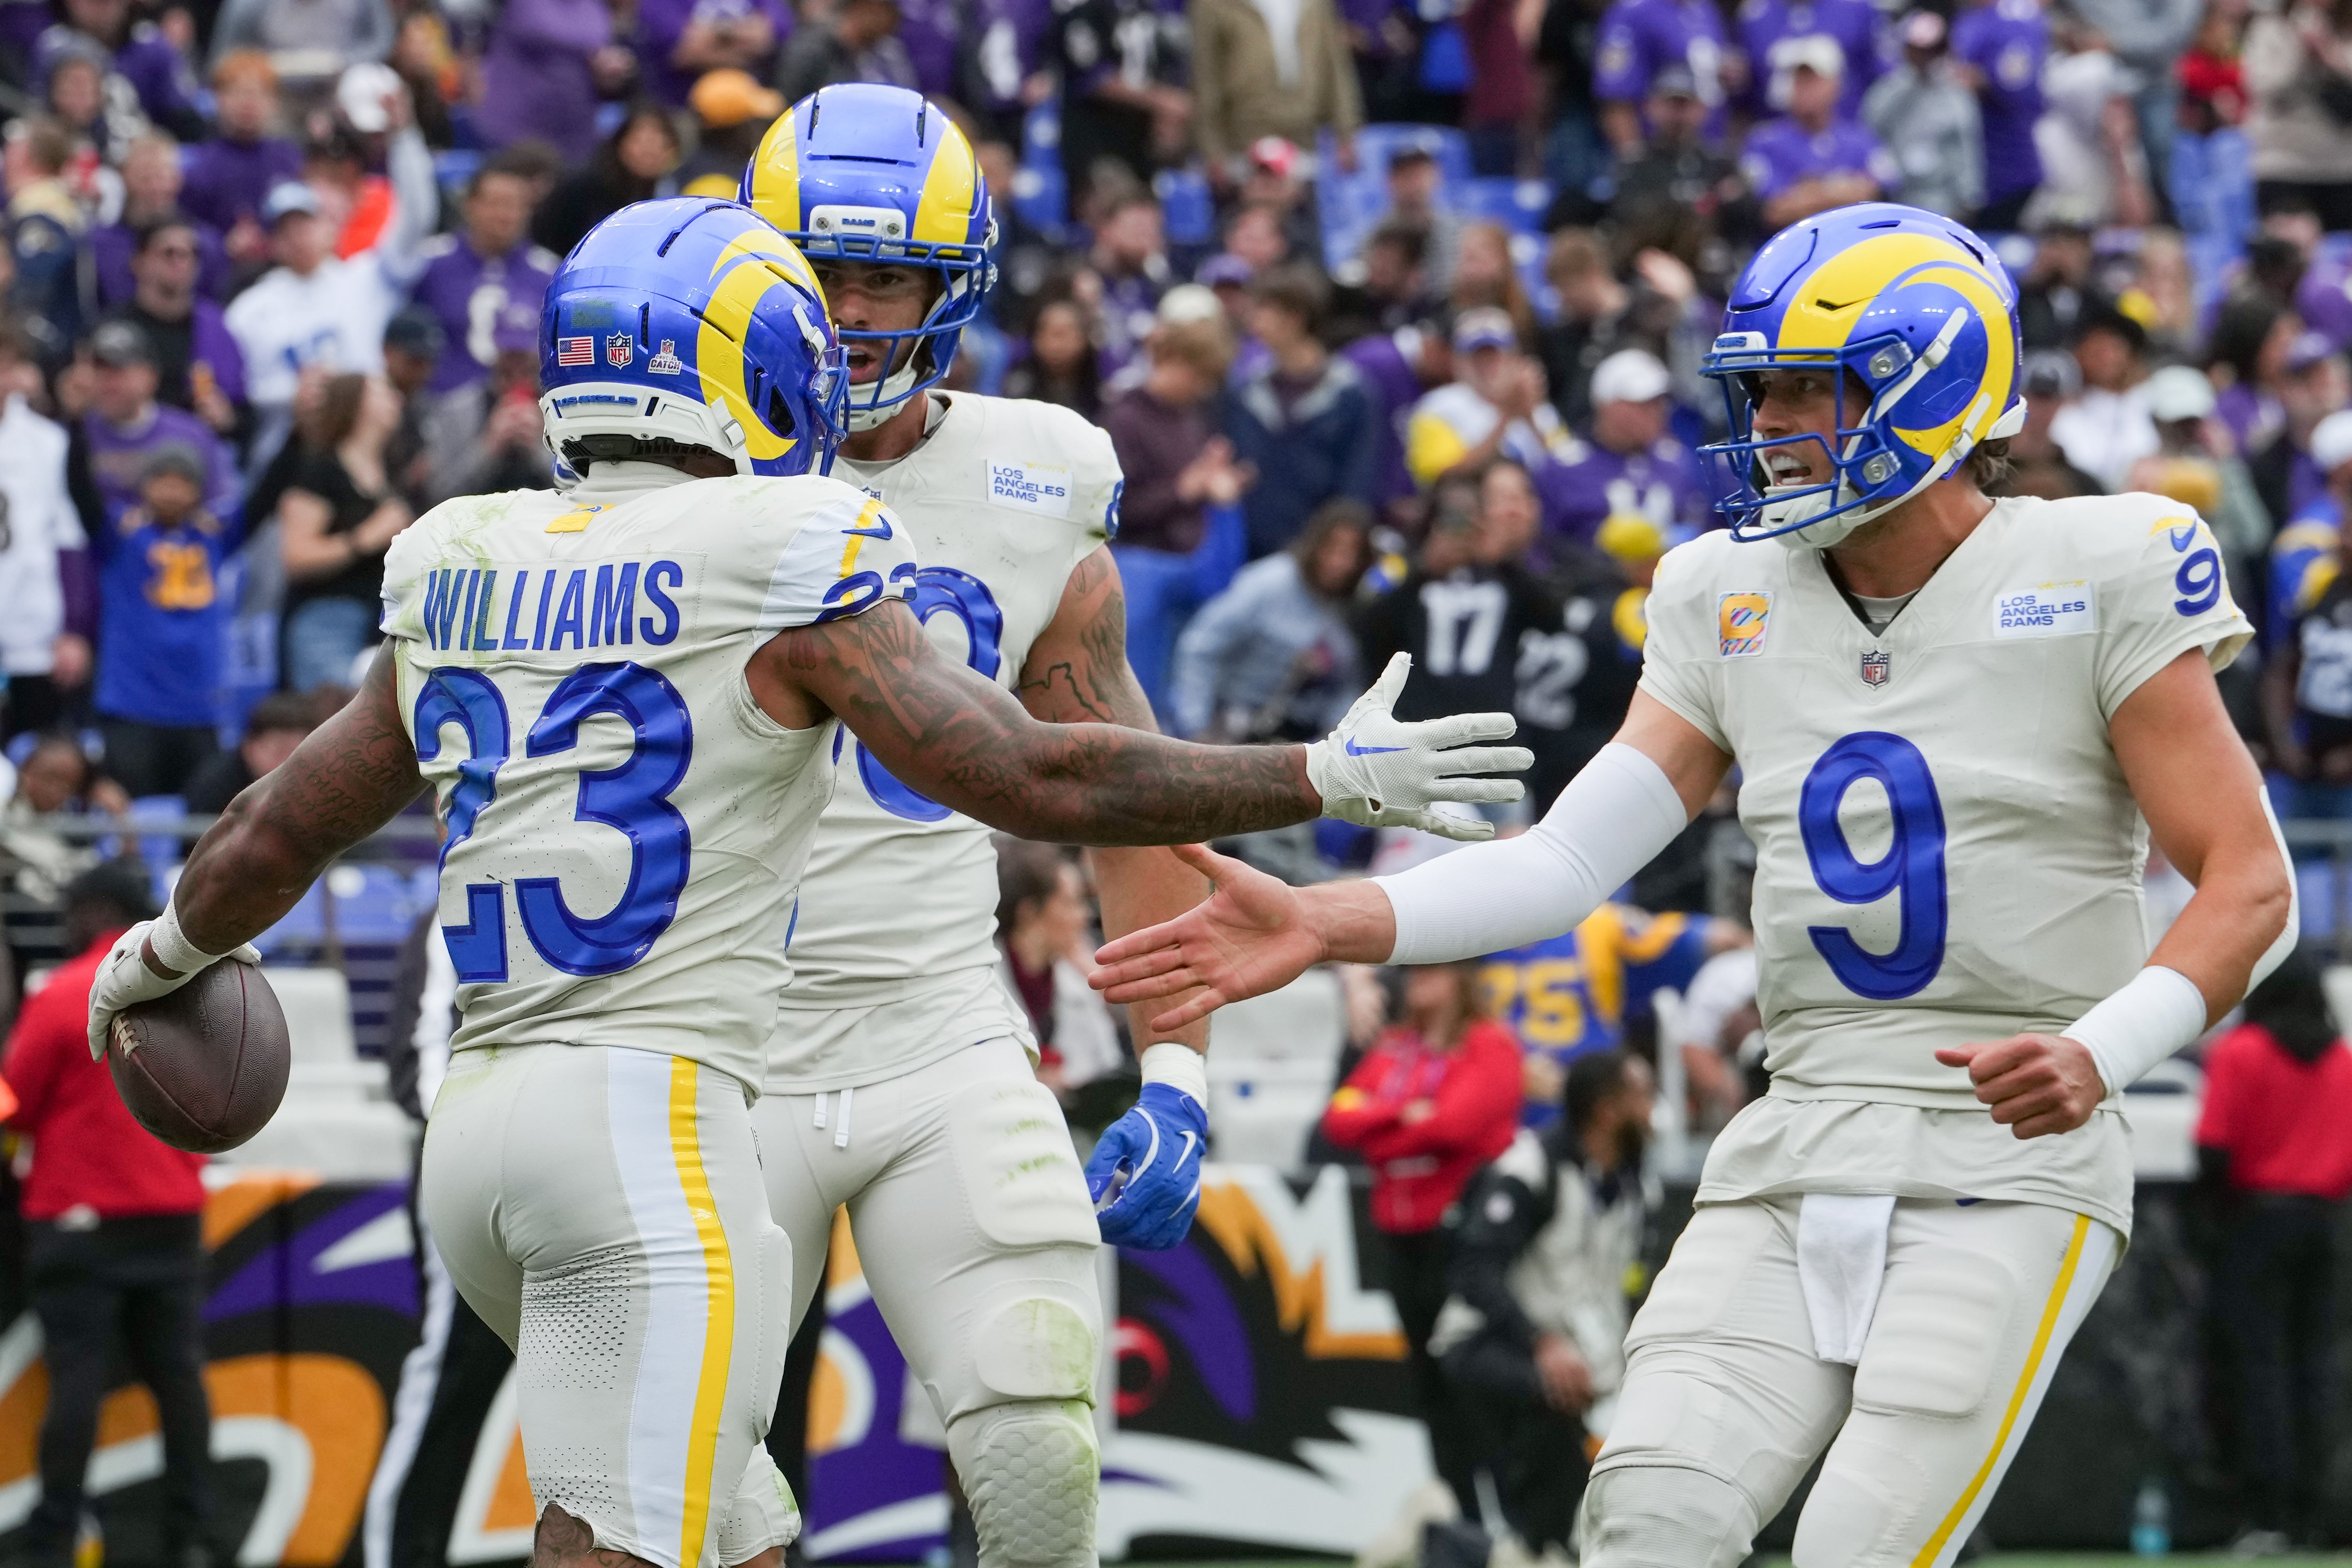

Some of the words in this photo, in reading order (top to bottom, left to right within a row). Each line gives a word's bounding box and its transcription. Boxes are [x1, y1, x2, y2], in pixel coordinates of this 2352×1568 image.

[842, 218, 875, 227] RAMS
[610, 349, 629, 363] NFL
[651, 359, 681, 370] CATCH
[578, 395, 638, 406] ANGELES
[994, 466, 1023, 479] LOS
[994, 476, 1065, 497] ANGELES
[995, 486, 1037, 502] RAMS
[2175, 548, 2221, 617] 9
[424, 560, 683, 652] WILLIAMS
[2001, 596, 2036, 607] LOS
[2001, 601, 2085, 618] ANGELES
[1420, 581, 1508, 676] 17
[2001, 616, 2053, 628] RAMS
[1865, 666, 1886, 682] NFL
[414, 661, 693, 983] 23
[1799, 731, 1948, 1000] 9
